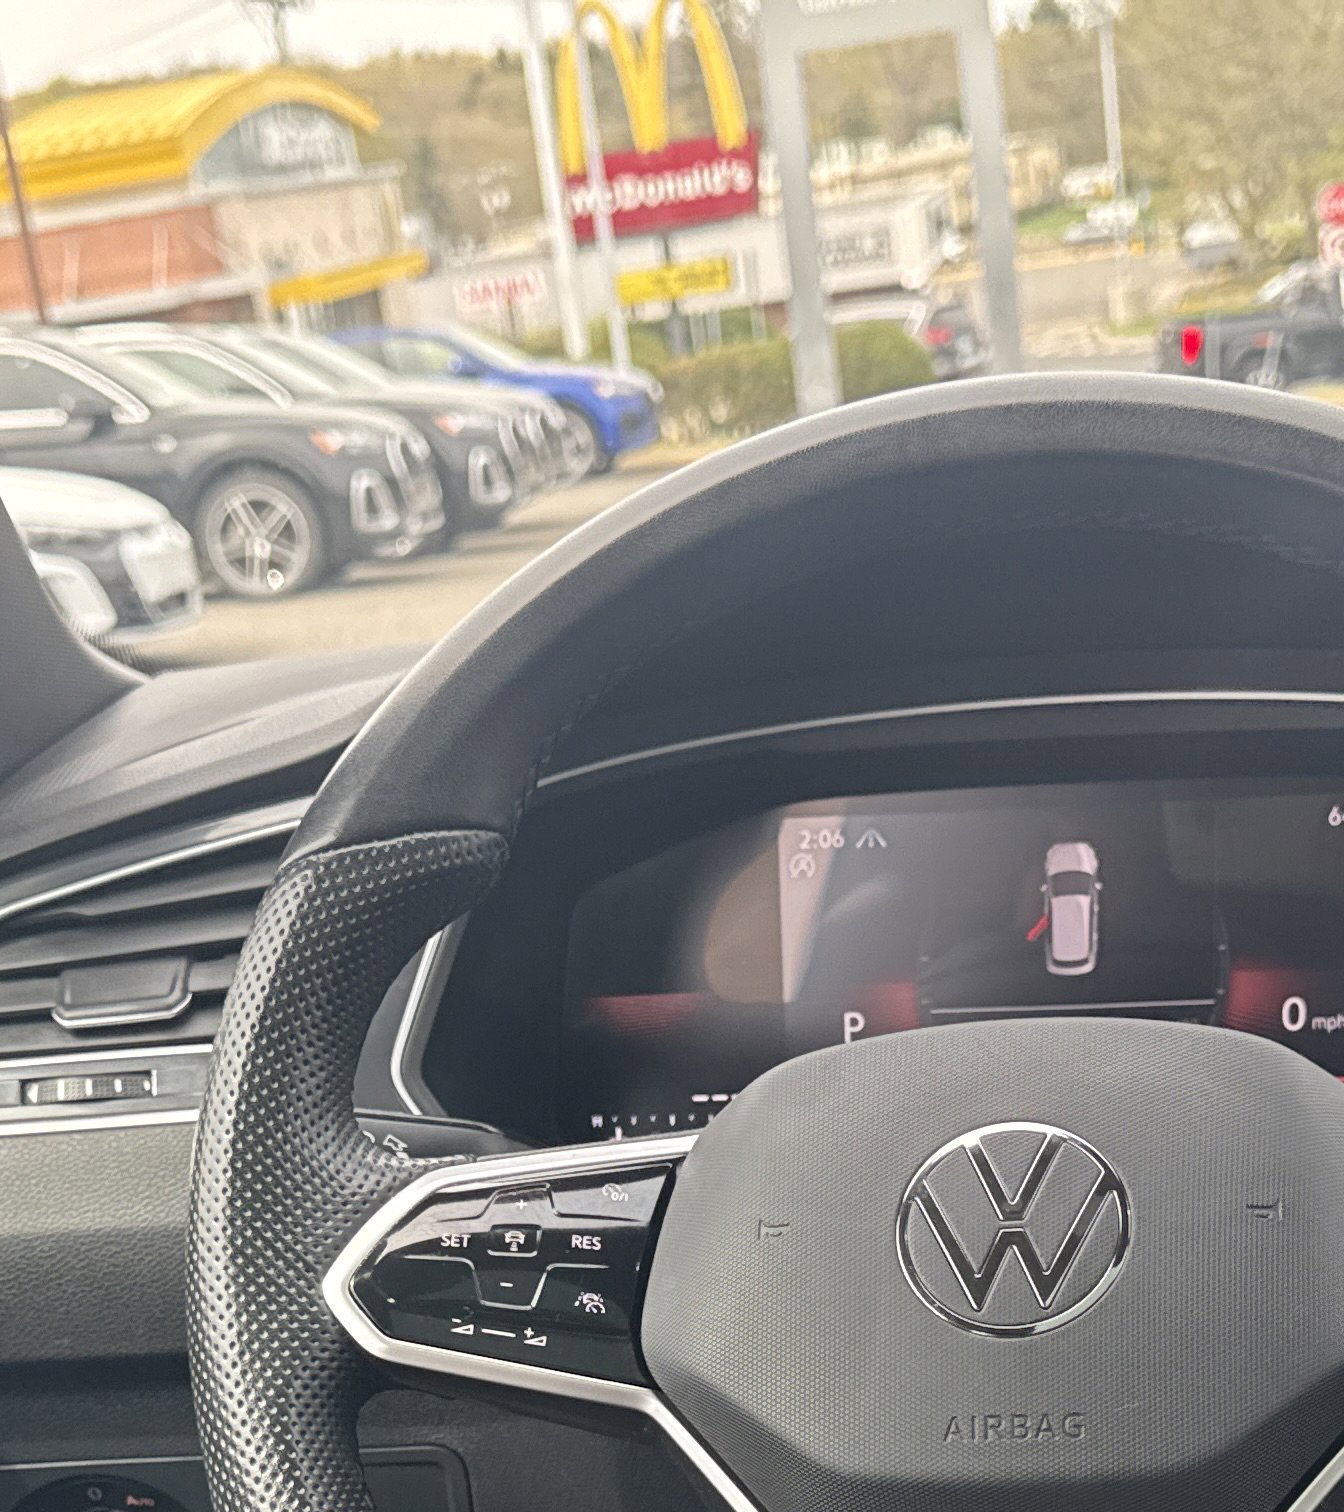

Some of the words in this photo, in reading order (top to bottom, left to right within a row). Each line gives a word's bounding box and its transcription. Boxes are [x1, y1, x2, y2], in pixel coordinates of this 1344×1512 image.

[799, 828, 845, 850] 2:06
[844, 1011, 866, 1043] P
[1281, 995, 1307, 1032] 0
[440, 1233, 472, 1249] SET
[571, 1233, 602, 1251] RES
[943, 1410, 1087, 1443] AIRBAG
